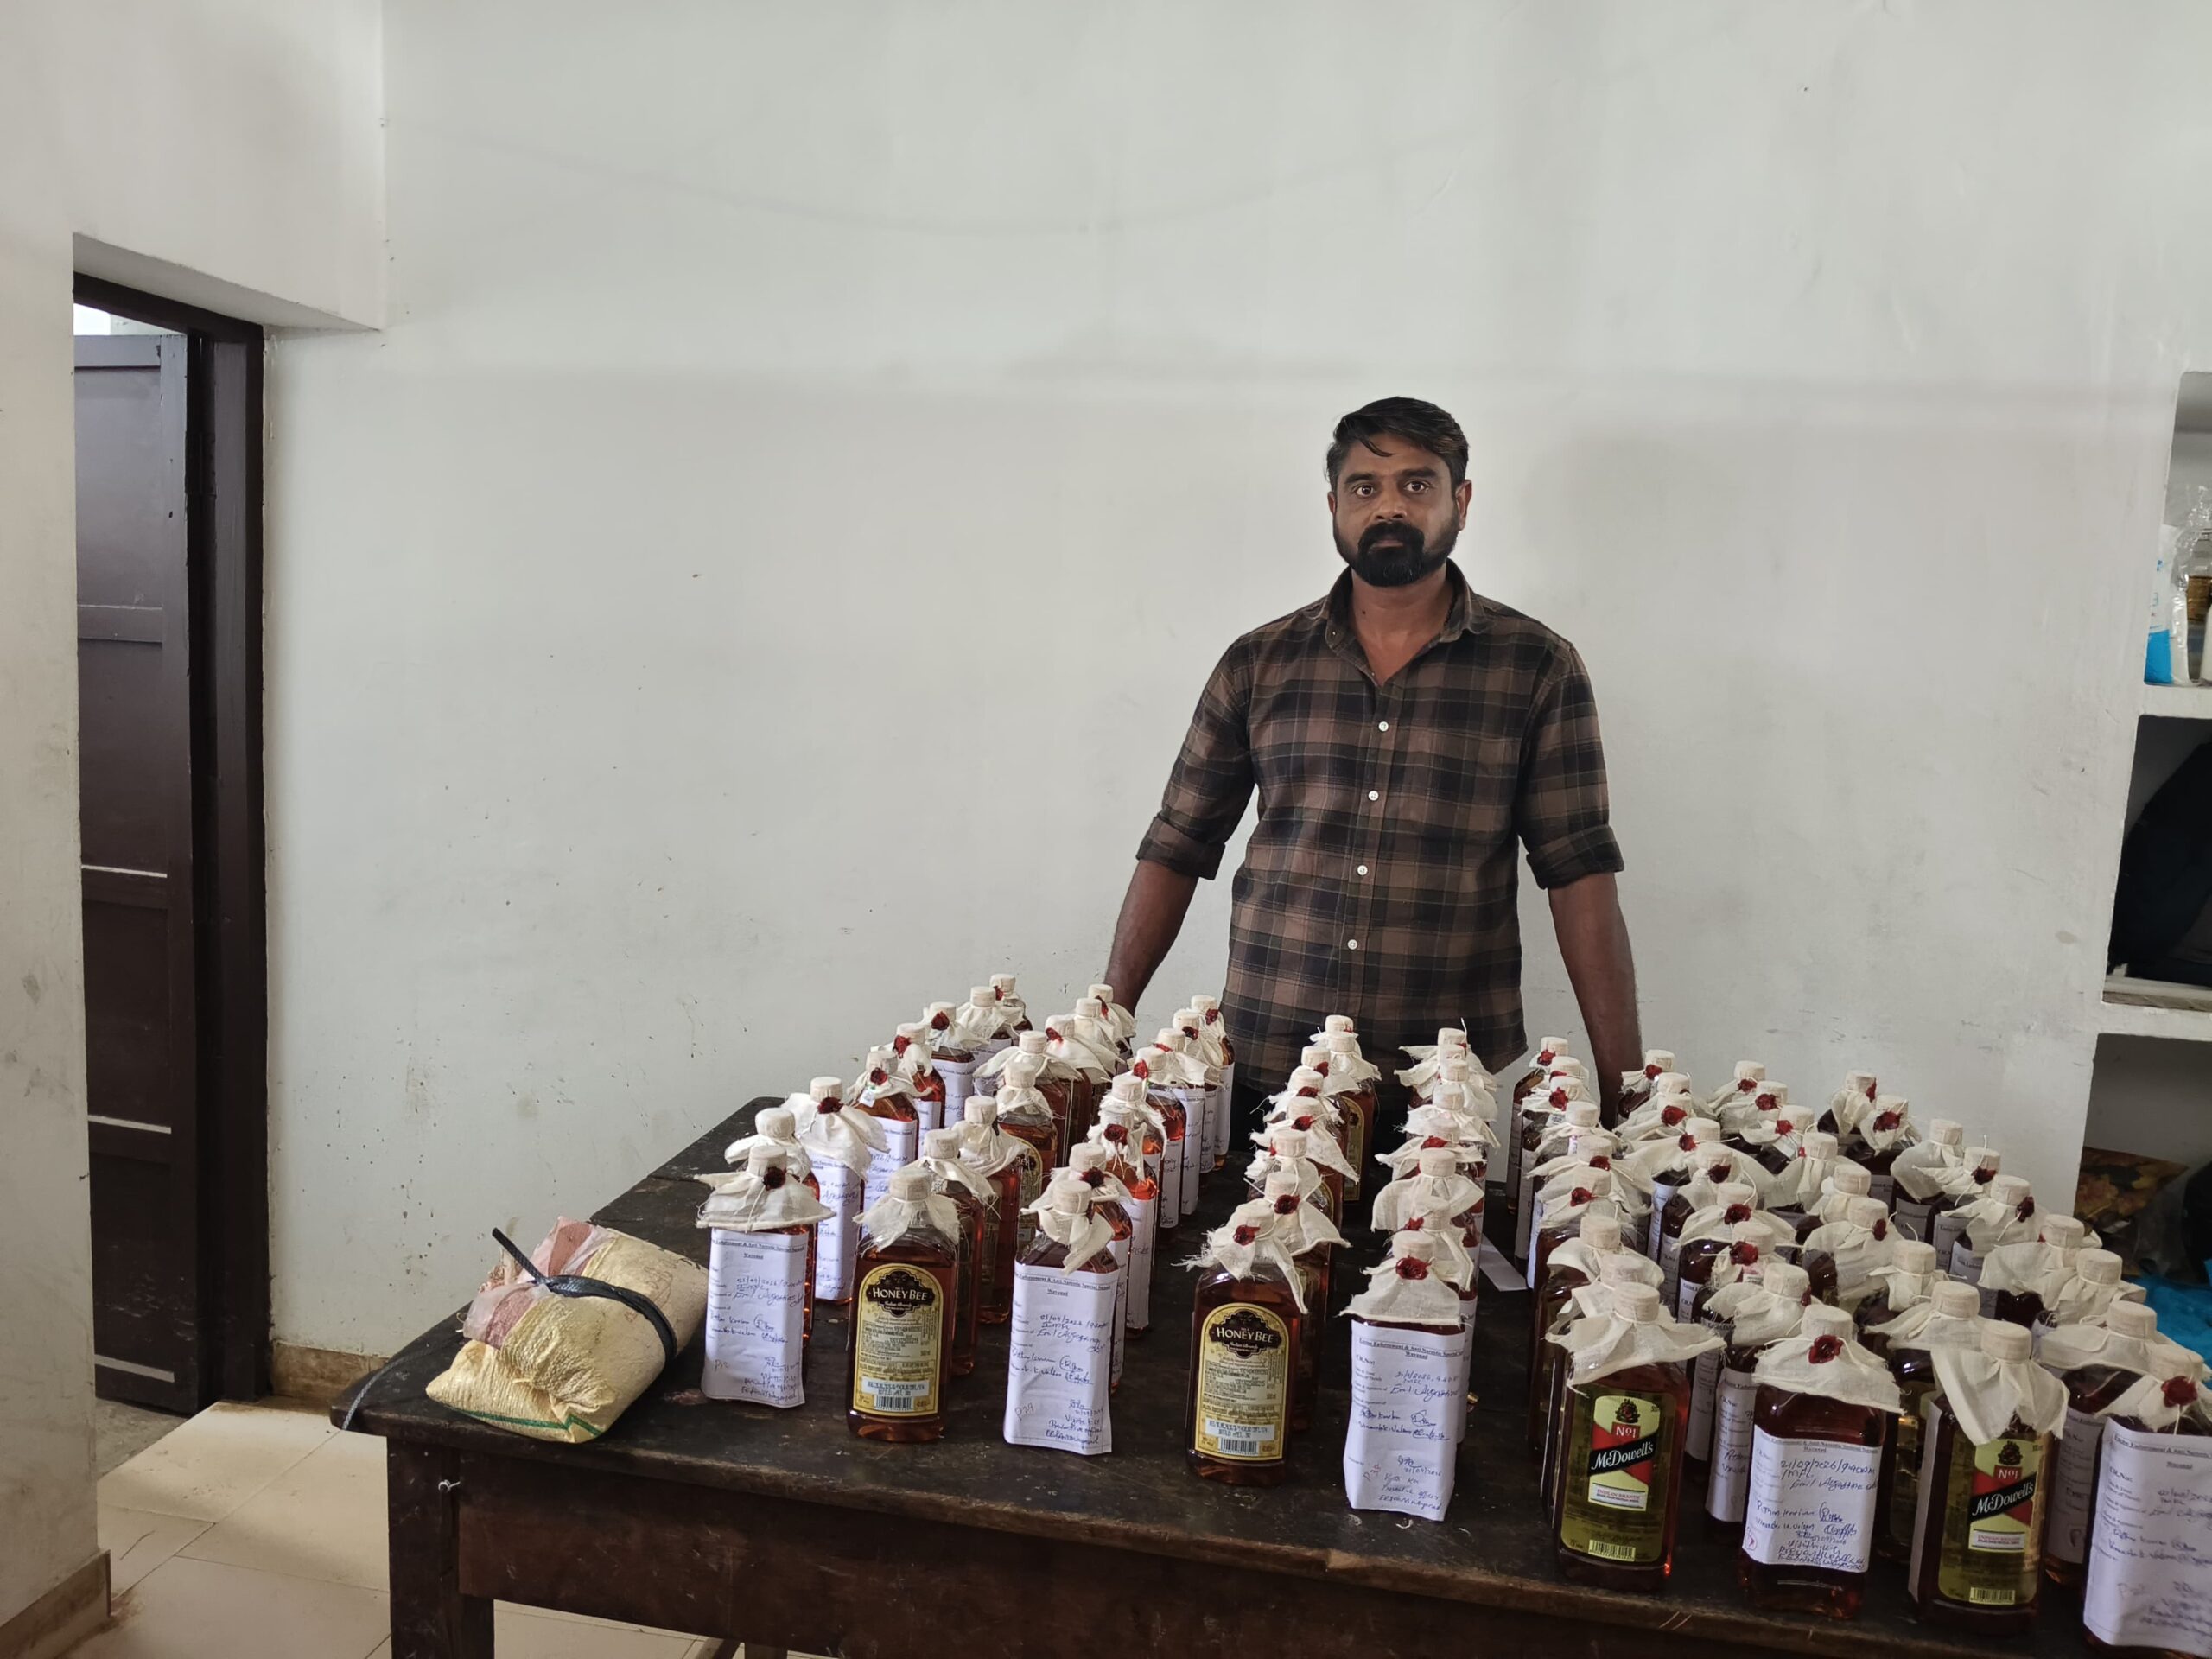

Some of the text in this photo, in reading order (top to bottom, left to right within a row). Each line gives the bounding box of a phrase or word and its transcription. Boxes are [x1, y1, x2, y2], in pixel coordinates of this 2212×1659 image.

[872, 1287, 929, 1301] HONEY BEE
[1216, 1326, 1274, 1343] HONEY BEE
[1591, 1440, 1654, 1471] McDowell's
[1971, 1480, 2035, 1517] McDowell's
